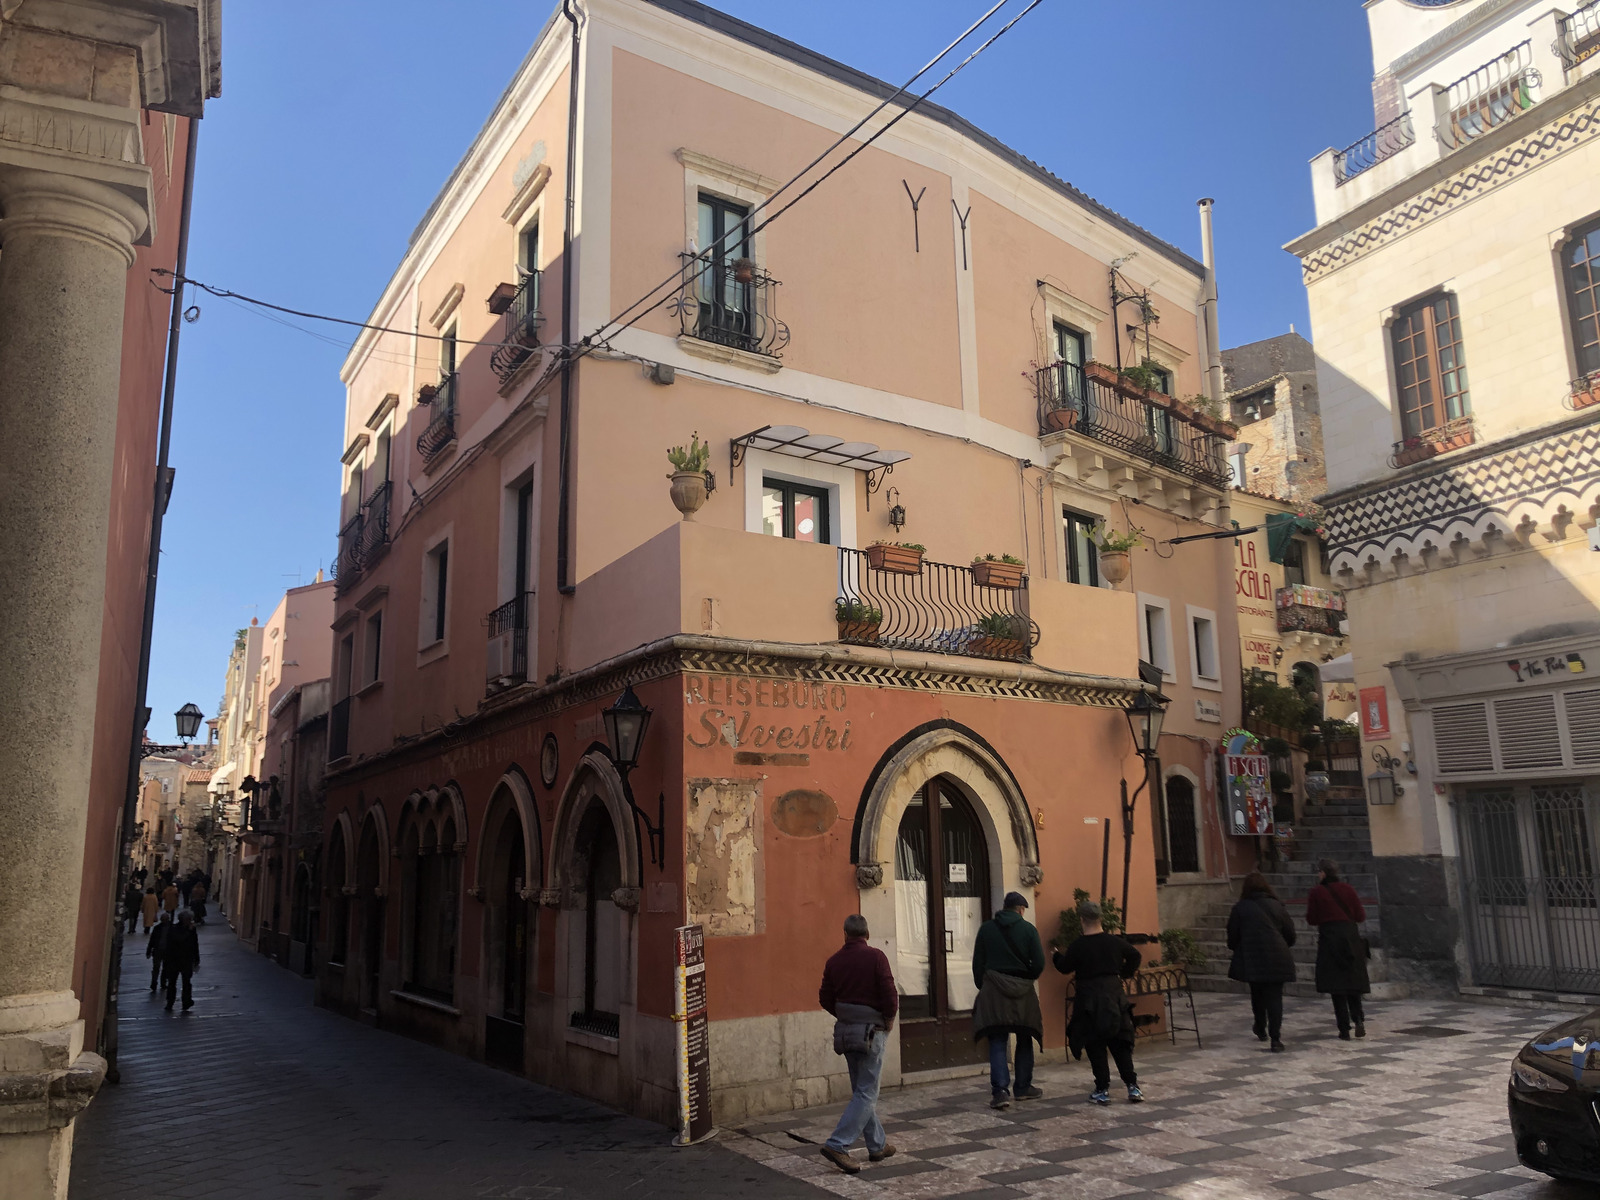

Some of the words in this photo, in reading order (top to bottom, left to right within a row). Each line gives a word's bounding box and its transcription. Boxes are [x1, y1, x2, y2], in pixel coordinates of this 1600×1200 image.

[1239, 539, 1257, 569] LA
[1544, 656, 1565, 674] Pub
[1228, 757, 1239, 776] LA
[1240, 757, 1269, 777] SCALA
